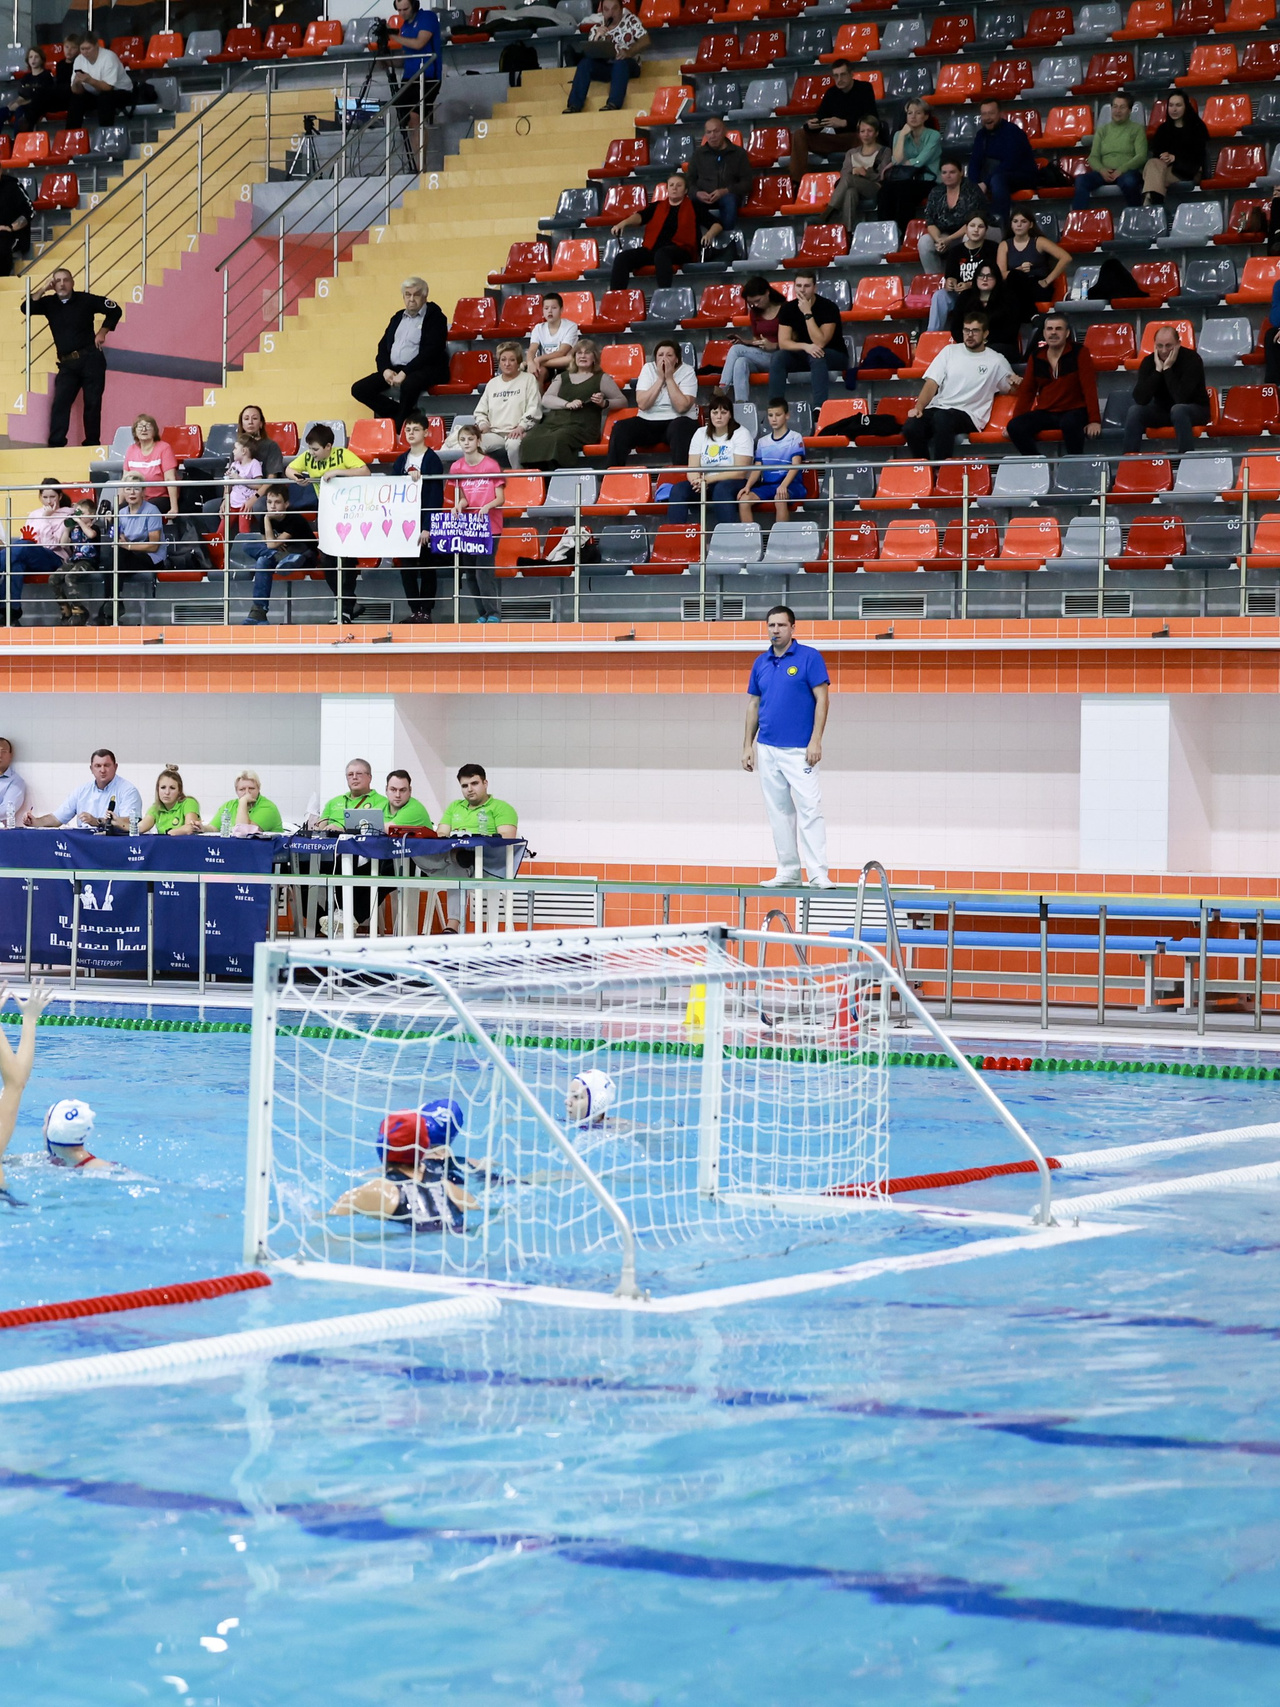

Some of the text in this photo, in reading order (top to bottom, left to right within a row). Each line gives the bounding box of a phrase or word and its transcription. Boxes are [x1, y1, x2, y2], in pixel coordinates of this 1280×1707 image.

[1107, 6, 1116, 15] 33
[1156, 2, 1165, 11] 34
[1056, 10, 1065, 19] 32
[959, 19, 968, 28] 30
[1007, 15, 1016, 24] 31
[329, 24, 339, 32] 27
[910, 22, 919, 31] 29
[817, 29, 826, 37] 27
[862, 27, 871, 36] 28
[770, 33, 779, 41] 26
[725, 38, 734, 46] 25
[1222, 47, 1231, 56] 36
[1118, 55, 1127, 63] 34
[968, 66, 976, 75] 31
[1017, 62, 1027, 71] 32
[918, 68, 927, 77] 30
[822, 77, 831, 86] 28
[678, 88, 687, 97] 25
[1236, 97, 1245, 106] 37
[478, 122, 488, 138] 9
[777, 129, 785, 138] 28
[290, 134, 300, 150] 9
[144, 145, 153, 157] 9
[429, 174, 438, 189] 8
[241, 185, 250, 200] 8
[1205, 205, 1215, 214] 42
[1041, 215, 1051, 224] 39
[1095, 211, 1105, 220] 40
[375, 229, 385, 243] 7
[187, 235, 196, 251] 7
[1160, 265, 1170, 274] 44
[1219, 261, 1229, 269] 45
[319, 280, 328, 297] 6
[886, 280, 895, 289] 39
[133, 286, 142, 303] 6
[581, 293, 589, 302] 33
[630, 292, 638, 300] 34
[531, 297, 539, 305] 32
[1117, 326, 1127, 335] 44
[1176, 323, 1186, 332] 45
[264, 335, 274, 352] 5
[894, 335, 904, 344] 40
[629, 348, 638, 356] 35
[479, 354, 487, 362] 32
[1262, 387, 1273, 396] 59
[14, 394, 24, 411] 4
[205, 391, 216, 406] 4
[743, 404, 753, 413] 50
[797, 403, 806, 412] 51
[853, 401, 862, 409] 52
[332, 422, 341, 430] 42
[431, 419, 440, 427] 44
[189, 426, 197, 435] 39
[283, 424, 291, 432] 41
[96, 448, 105, 461] 3
[431, 513, 443, 521] ВОТ
[630, 530, 640, 539] 55
[77, 958, 122, 966] АНКТ-ПЕТЕРБУРГ
[65, 1108, 78, 1120] 8
